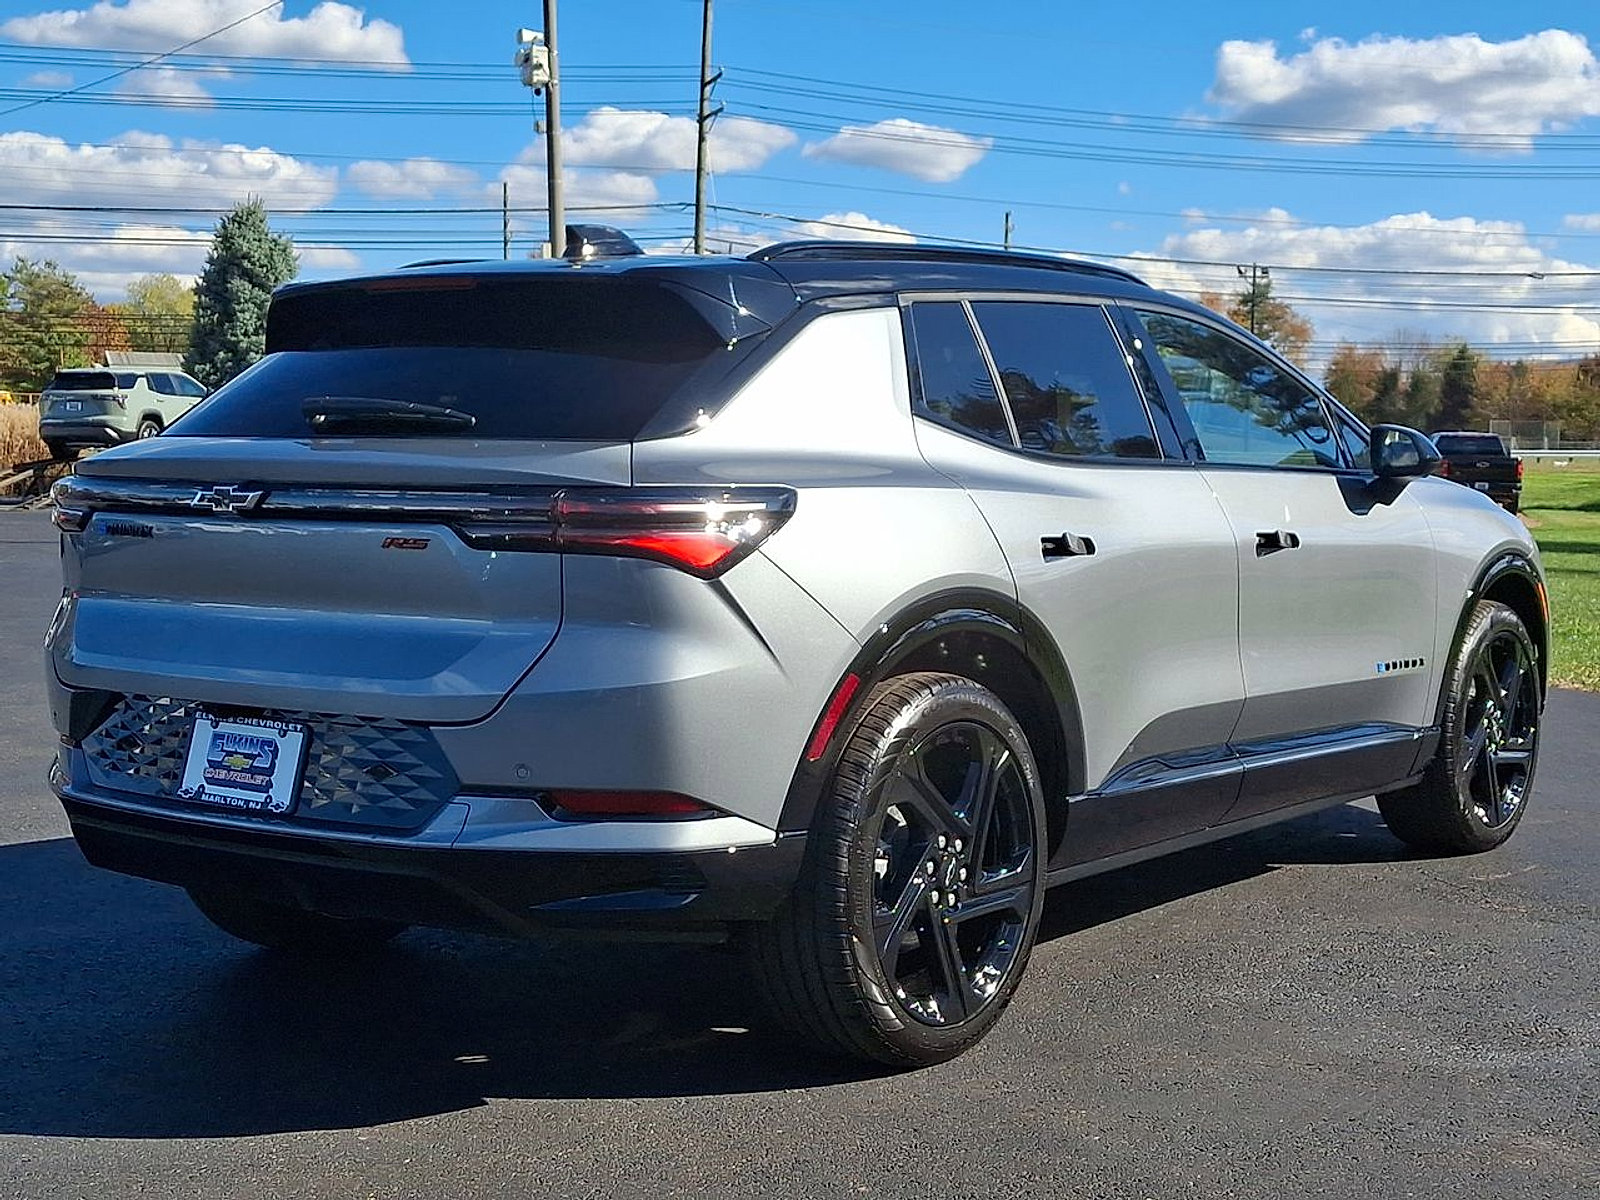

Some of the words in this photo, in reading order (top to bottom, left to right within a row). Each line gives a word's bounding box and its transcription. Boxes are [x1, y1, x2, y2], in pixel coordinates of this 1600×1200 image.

[381, 536, 431, 549] RS
[236, 717, 304, 731] CHEVROLET
[207, 731, 276, 768] ELKINS
[204, 768, 270, 786] CHEVROLET
[201, 793, 247, 809] MARLTON,
[248, 801, 262, 809] NJ
